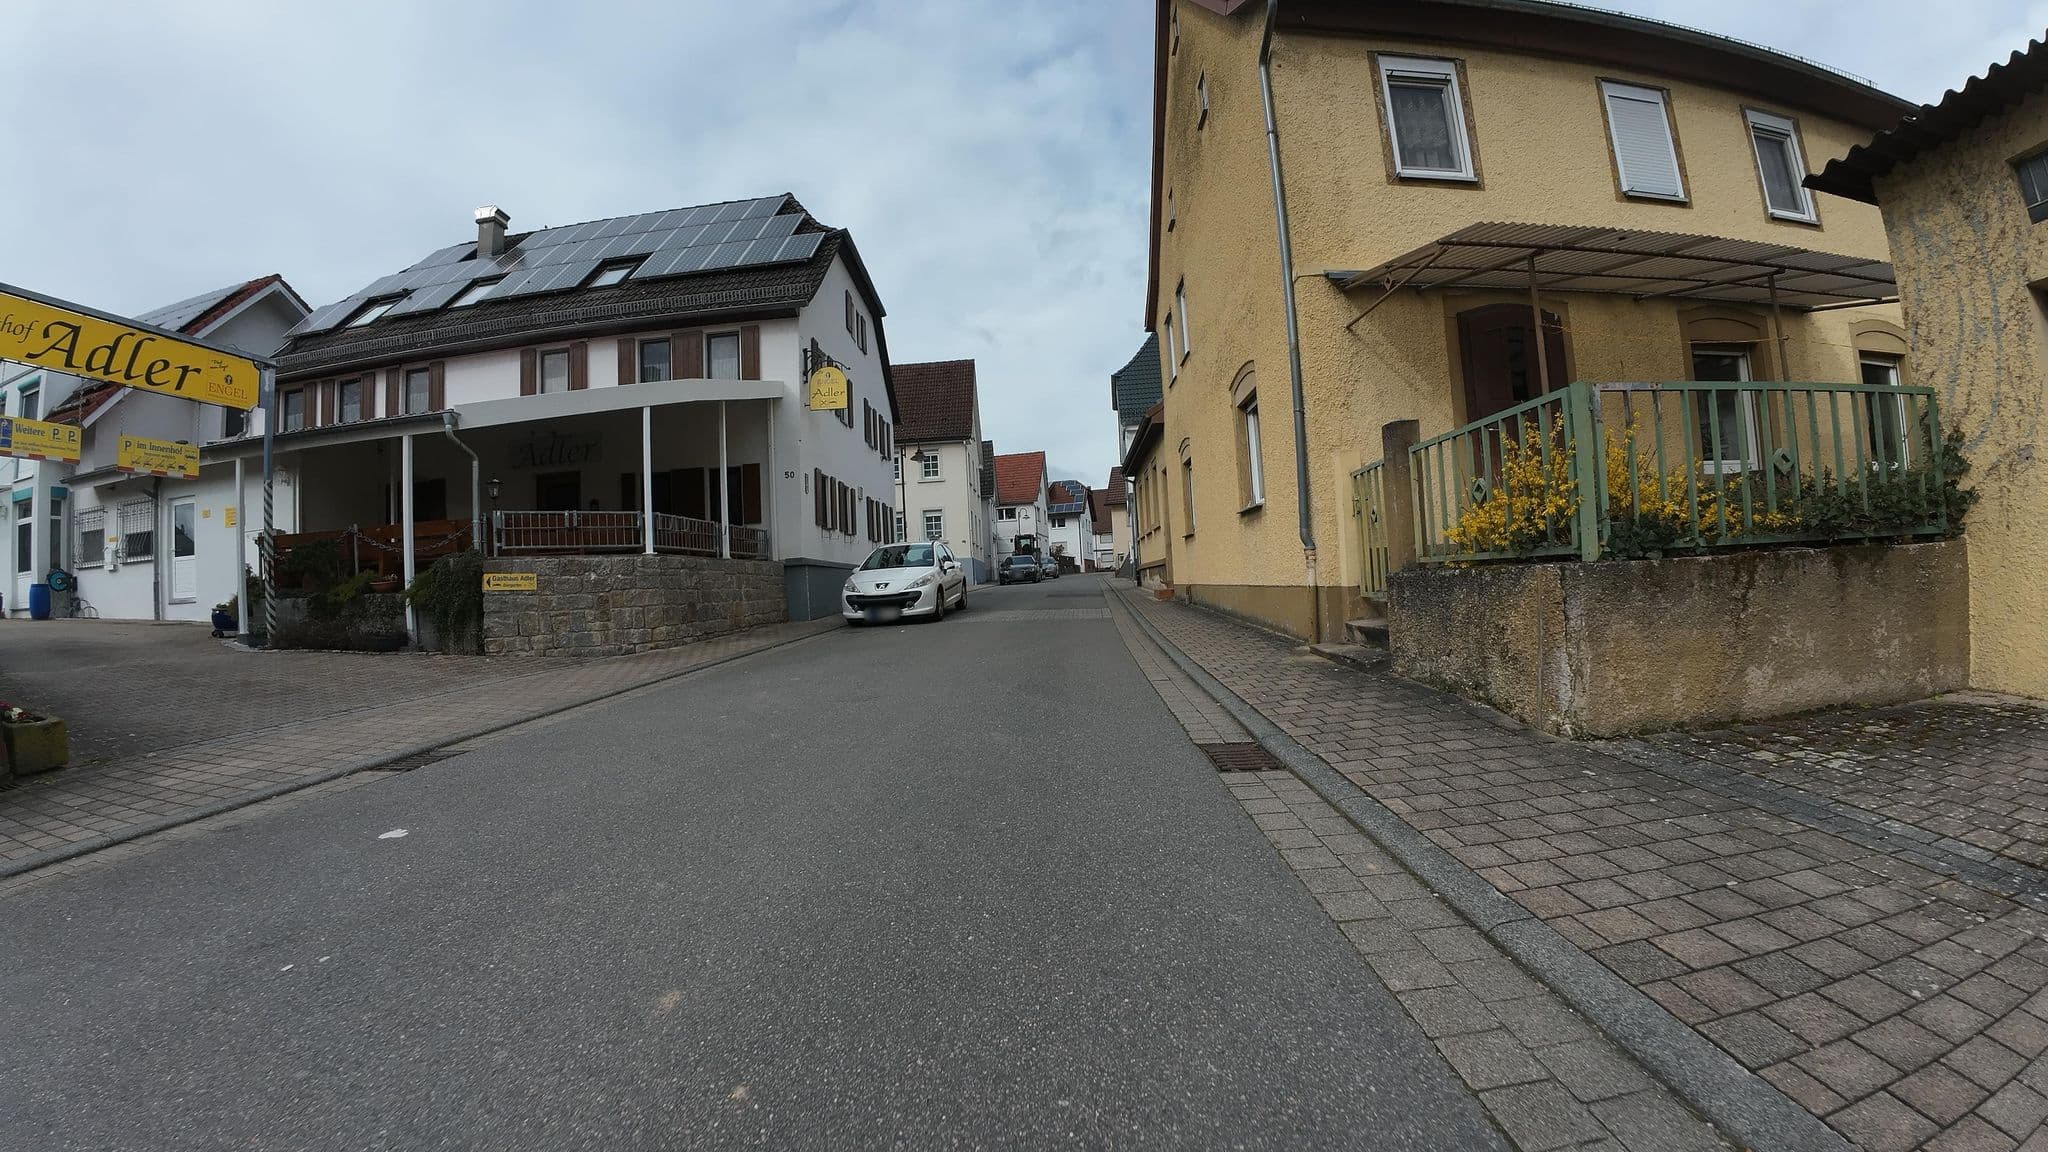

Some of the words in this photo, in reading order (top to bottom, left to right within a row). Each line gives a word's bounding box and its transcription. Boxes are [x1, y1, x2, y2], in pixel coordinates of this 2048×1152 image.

[0, 313, 39, 343] hof
[25, 321, 202, 391] Adler
[208, 382, 248, 400] ENGEL
[812, 387, 846, 399] Adler
[15, 424, 46, 437] Weitere
[124, 440, 132, 451] P
[136, 440, 147, 450] im
[149, 442, 183, 455] Innenhof
[784, 470, 795, 479] 50
